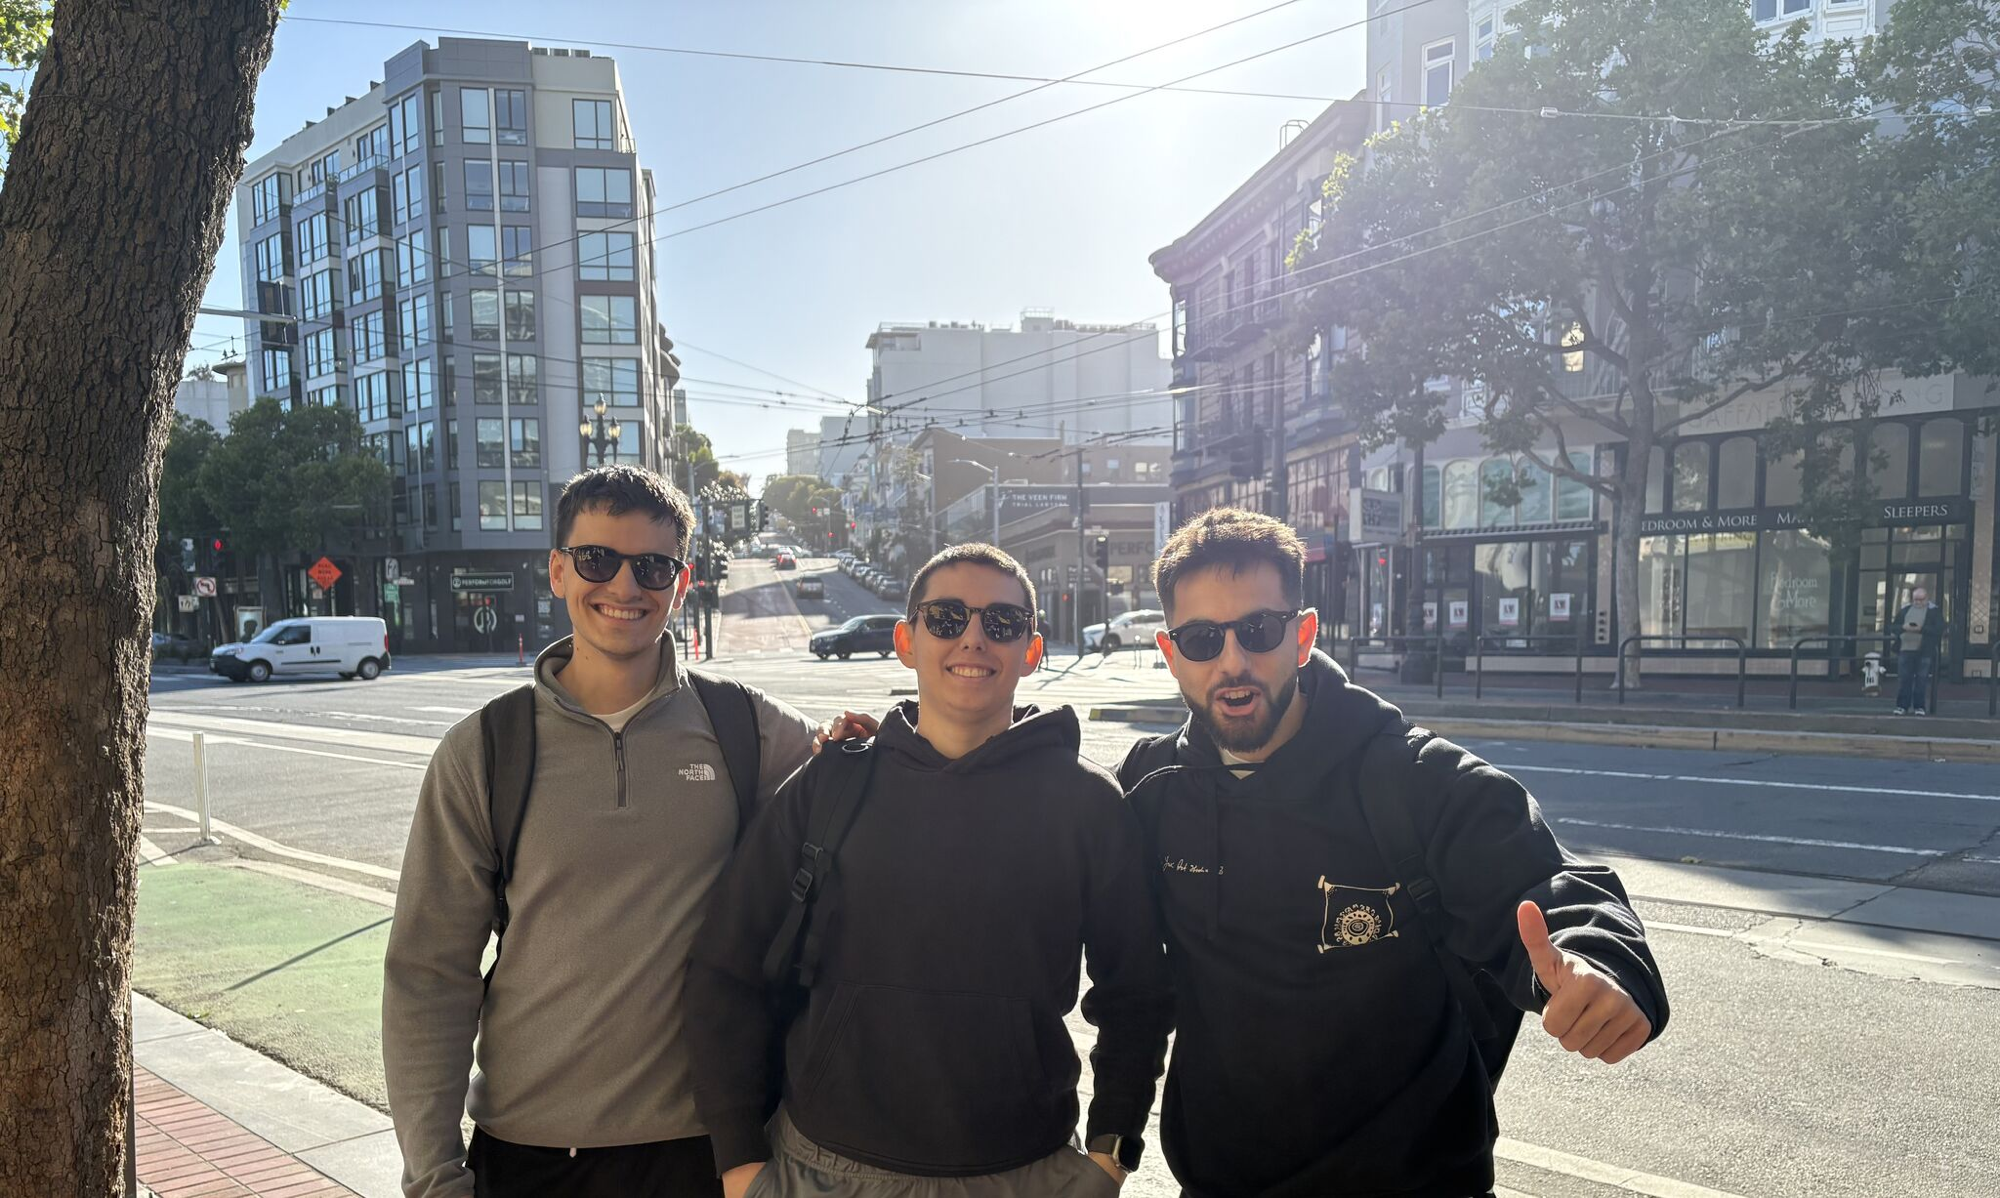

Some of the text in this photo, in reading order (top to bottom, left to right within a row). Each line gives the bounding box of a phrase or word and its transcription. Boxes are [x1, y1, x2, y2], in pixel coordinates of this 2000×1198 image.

[1884, 504, 1948, 519] SLEEPERS
[1641, 514, 1758, 532] EDROOM & MORE
[1110, 541, 1155, 555] PERFO
